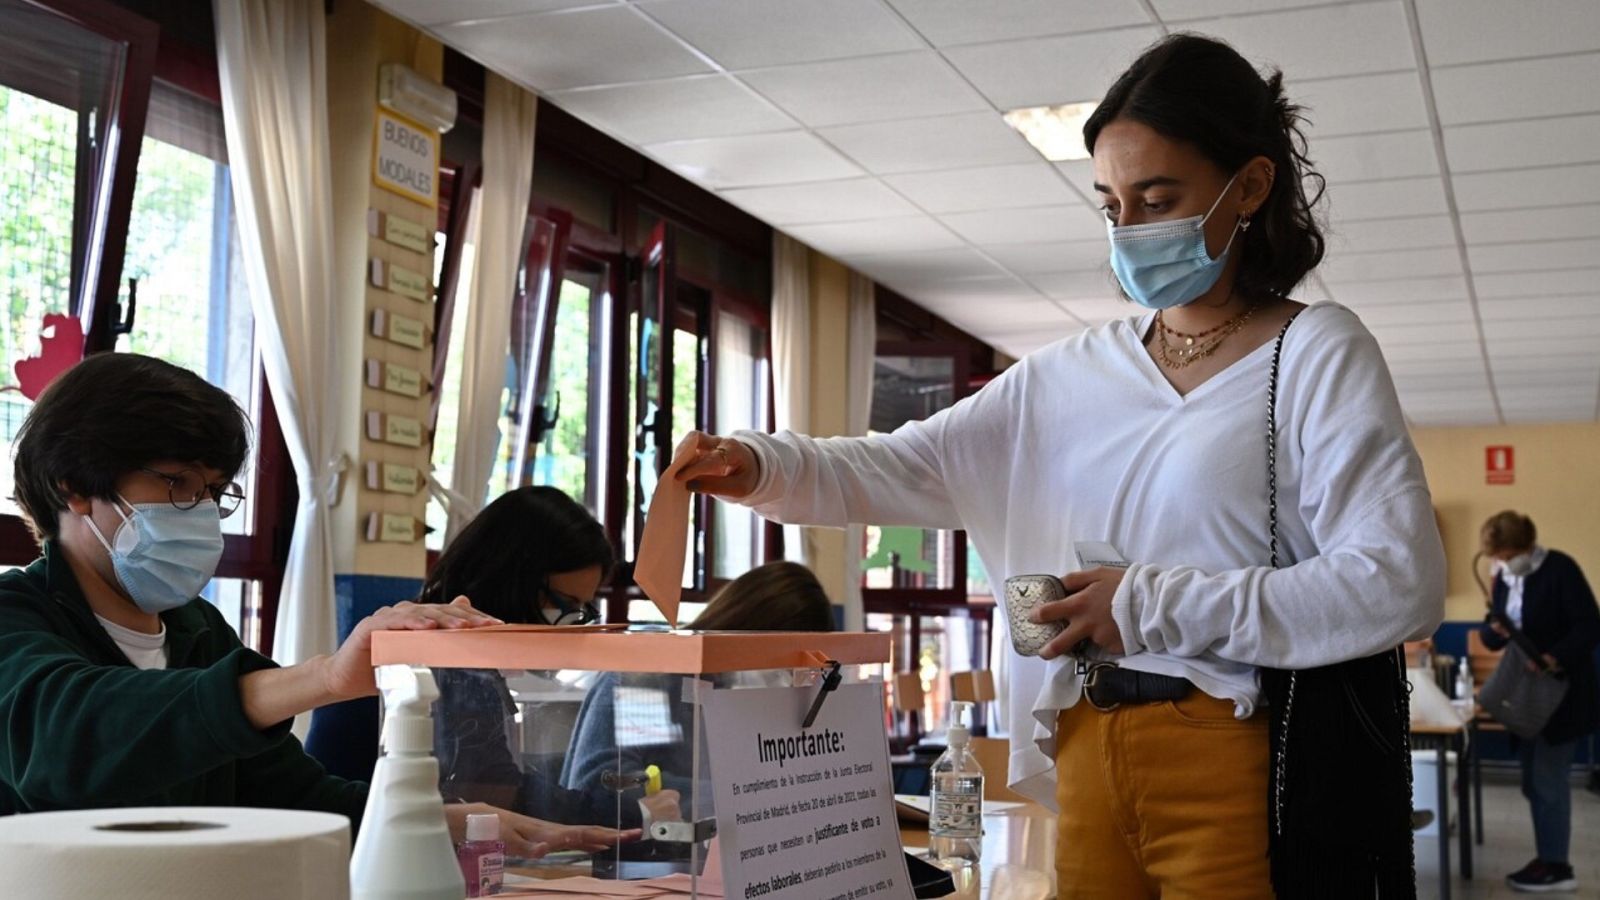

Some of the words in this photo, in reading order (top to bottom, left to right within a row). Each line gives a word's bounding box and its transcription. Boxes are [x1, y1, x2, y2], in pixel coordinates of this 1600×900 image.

[383, 119, 429, 158] BUENOS
[378, 155, 432, 195] MODALES
[757, 728, 845, 768] Importante:
[732, 783, 741, 796] En
[742, 778, 779, 795] cumplimiento
[780, 775, 788, 788] de
[788, 773, 795, 786] la
[823, 768, 831, 780] de
[832, 766, 838, 779] la
[839, 765, 853, 778] Junta
[854, 760, 873, 775] Electoral
[735, 809, 762, 825] Provincial
[763, 806, 771, 821] de
[770, 803, 791, 819] Madrid,
[791, 801, 799, 815] de
[798, 799, 811, 813] fecha
[811, 797, 819, 811] 20
[818, 796, 826, 809] de
[826, 793, 837, 807] abril
[837, 793, 844, 805] de
[740, 845, 765, 863] personas
[766, 842, 778, 856] que
[780, 835, 804, 851] necesiten
[805, 834, 813, 845] un
[813, 823, 849, 845] justificante
[850, 818, 859, 833] de
[860, 816, 875, 831] voto
[876, 815, 881, 827] a
[744, 881, 771, 900] efectos
[875, 848, 882, 861] de
